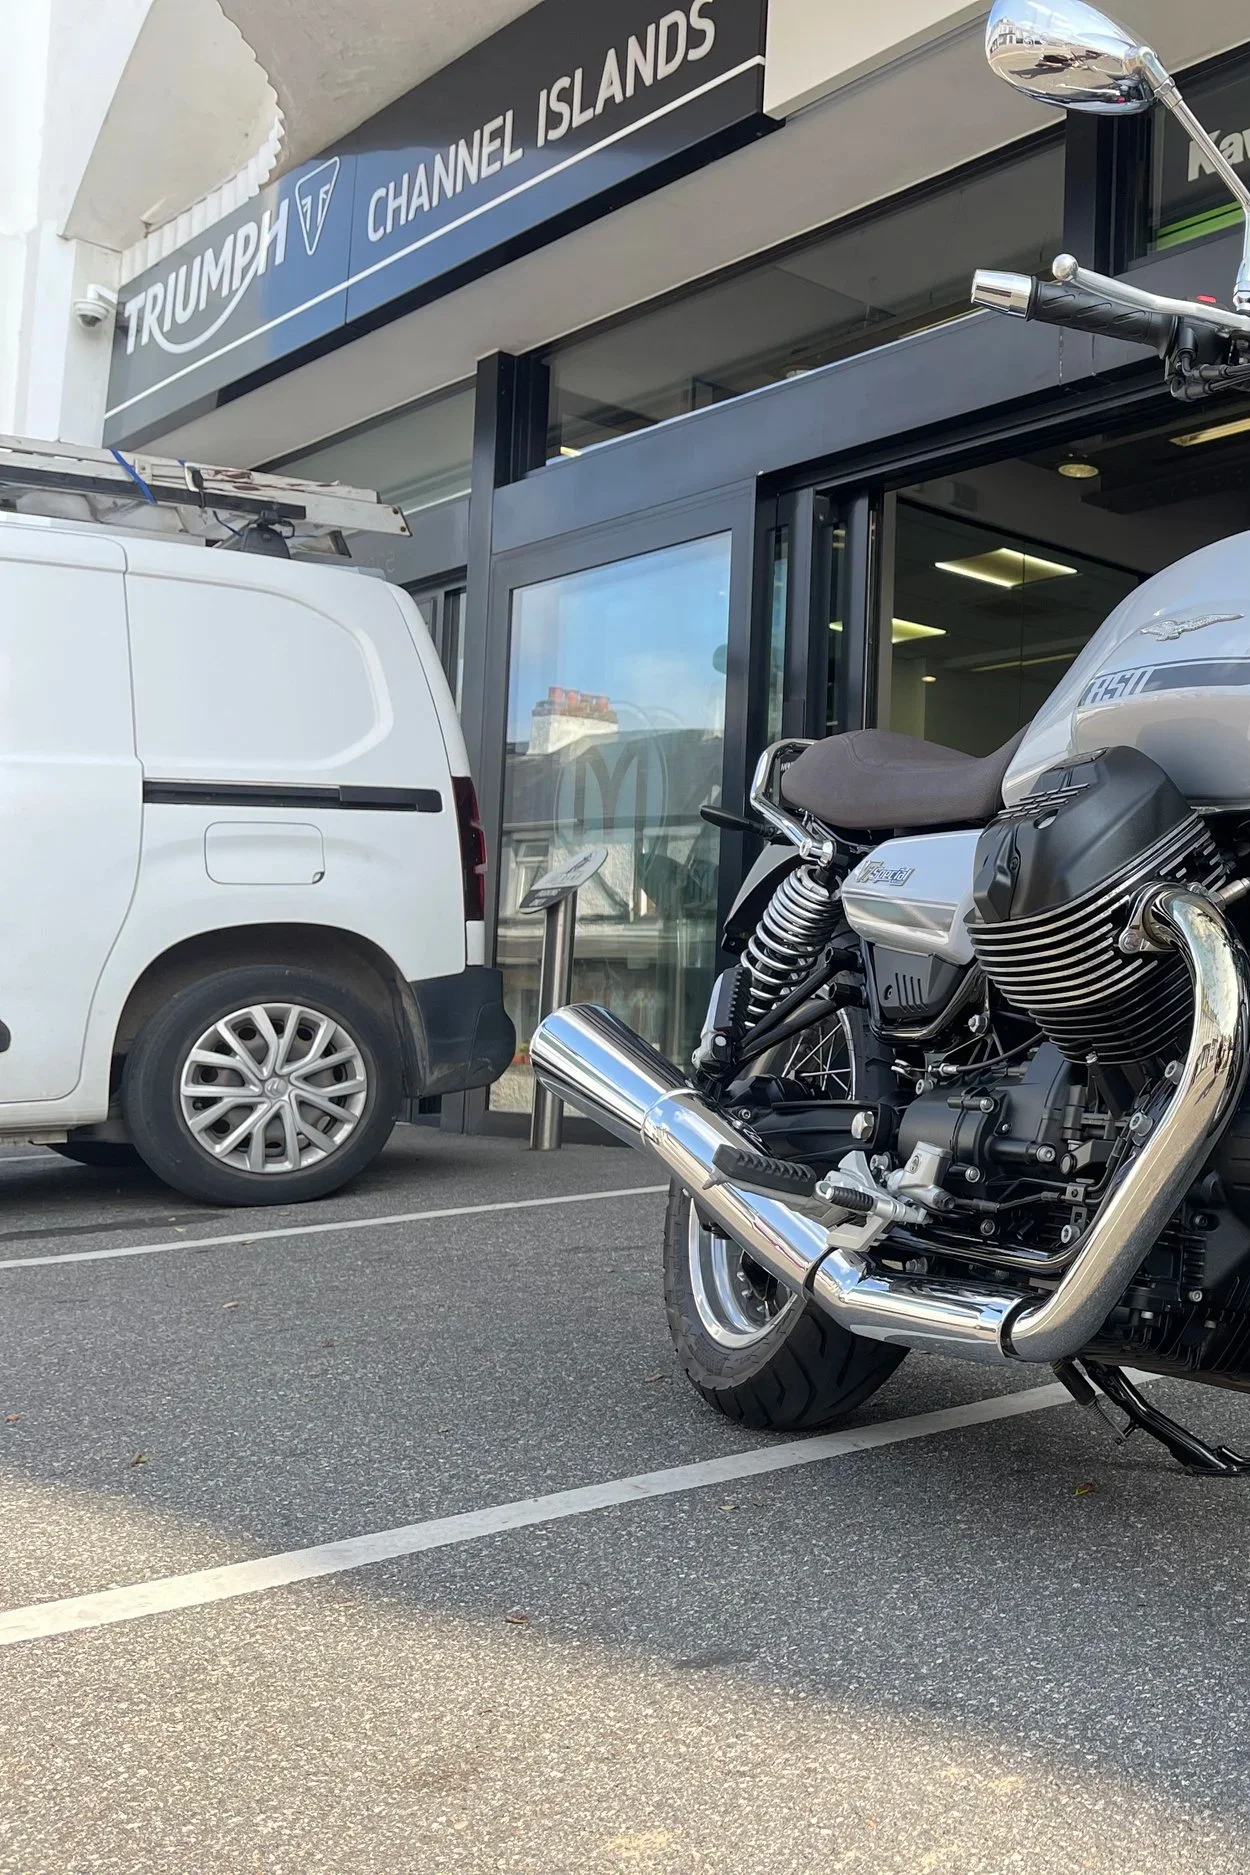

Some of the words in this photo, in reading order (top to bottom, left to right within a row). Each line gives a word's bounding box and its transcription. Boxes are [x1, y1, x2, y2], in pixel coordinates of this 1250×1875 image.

[367, 109, 523, 243] CHANNEL
[536, 0, 716, 148] ISLANDS
[124, 198, 290, 355] TRIUMPH
